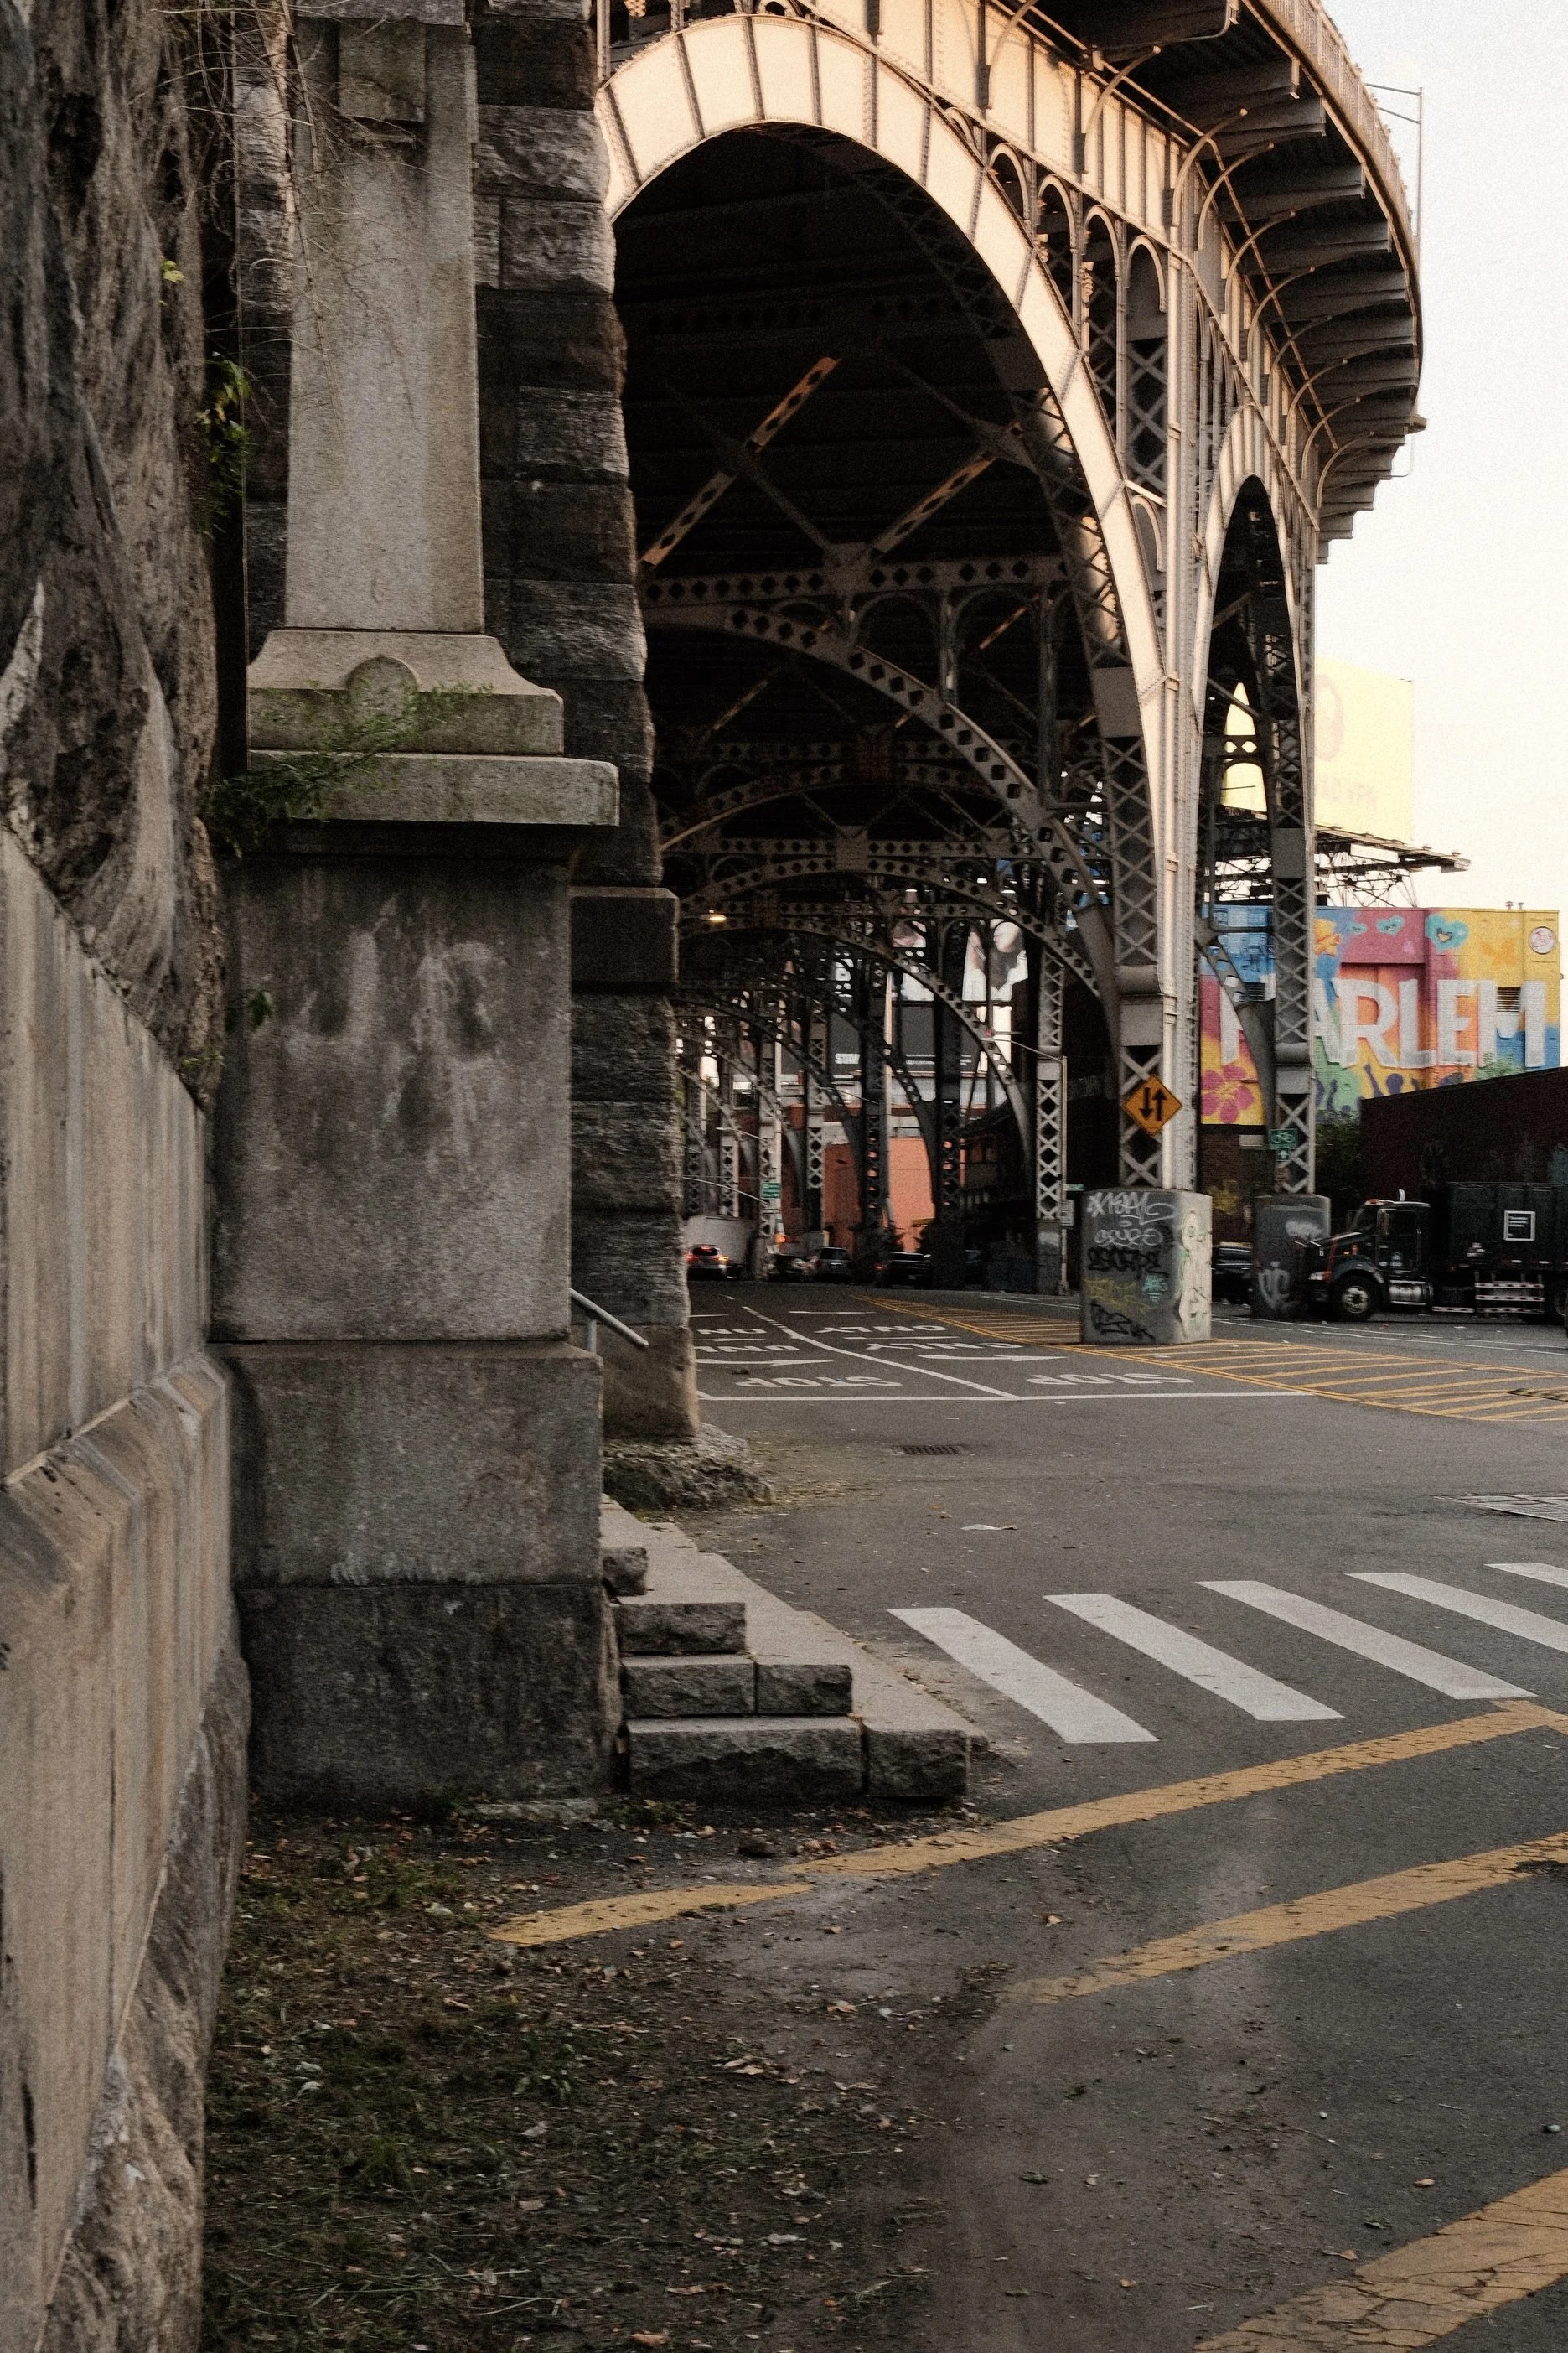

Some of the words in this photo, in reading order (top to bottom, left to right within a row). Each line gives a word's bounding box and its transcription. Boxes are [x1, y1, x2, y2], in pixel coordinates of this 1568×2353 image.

[814, 1324, 948, 1334] ONLY
[693, 1345, 800, 1353] ONL
[865, 1342, 1023, 1350] ONLY
[734, 1376, 903, 1388] STOP
[1025, 1372, 1195, 1385] STOP
